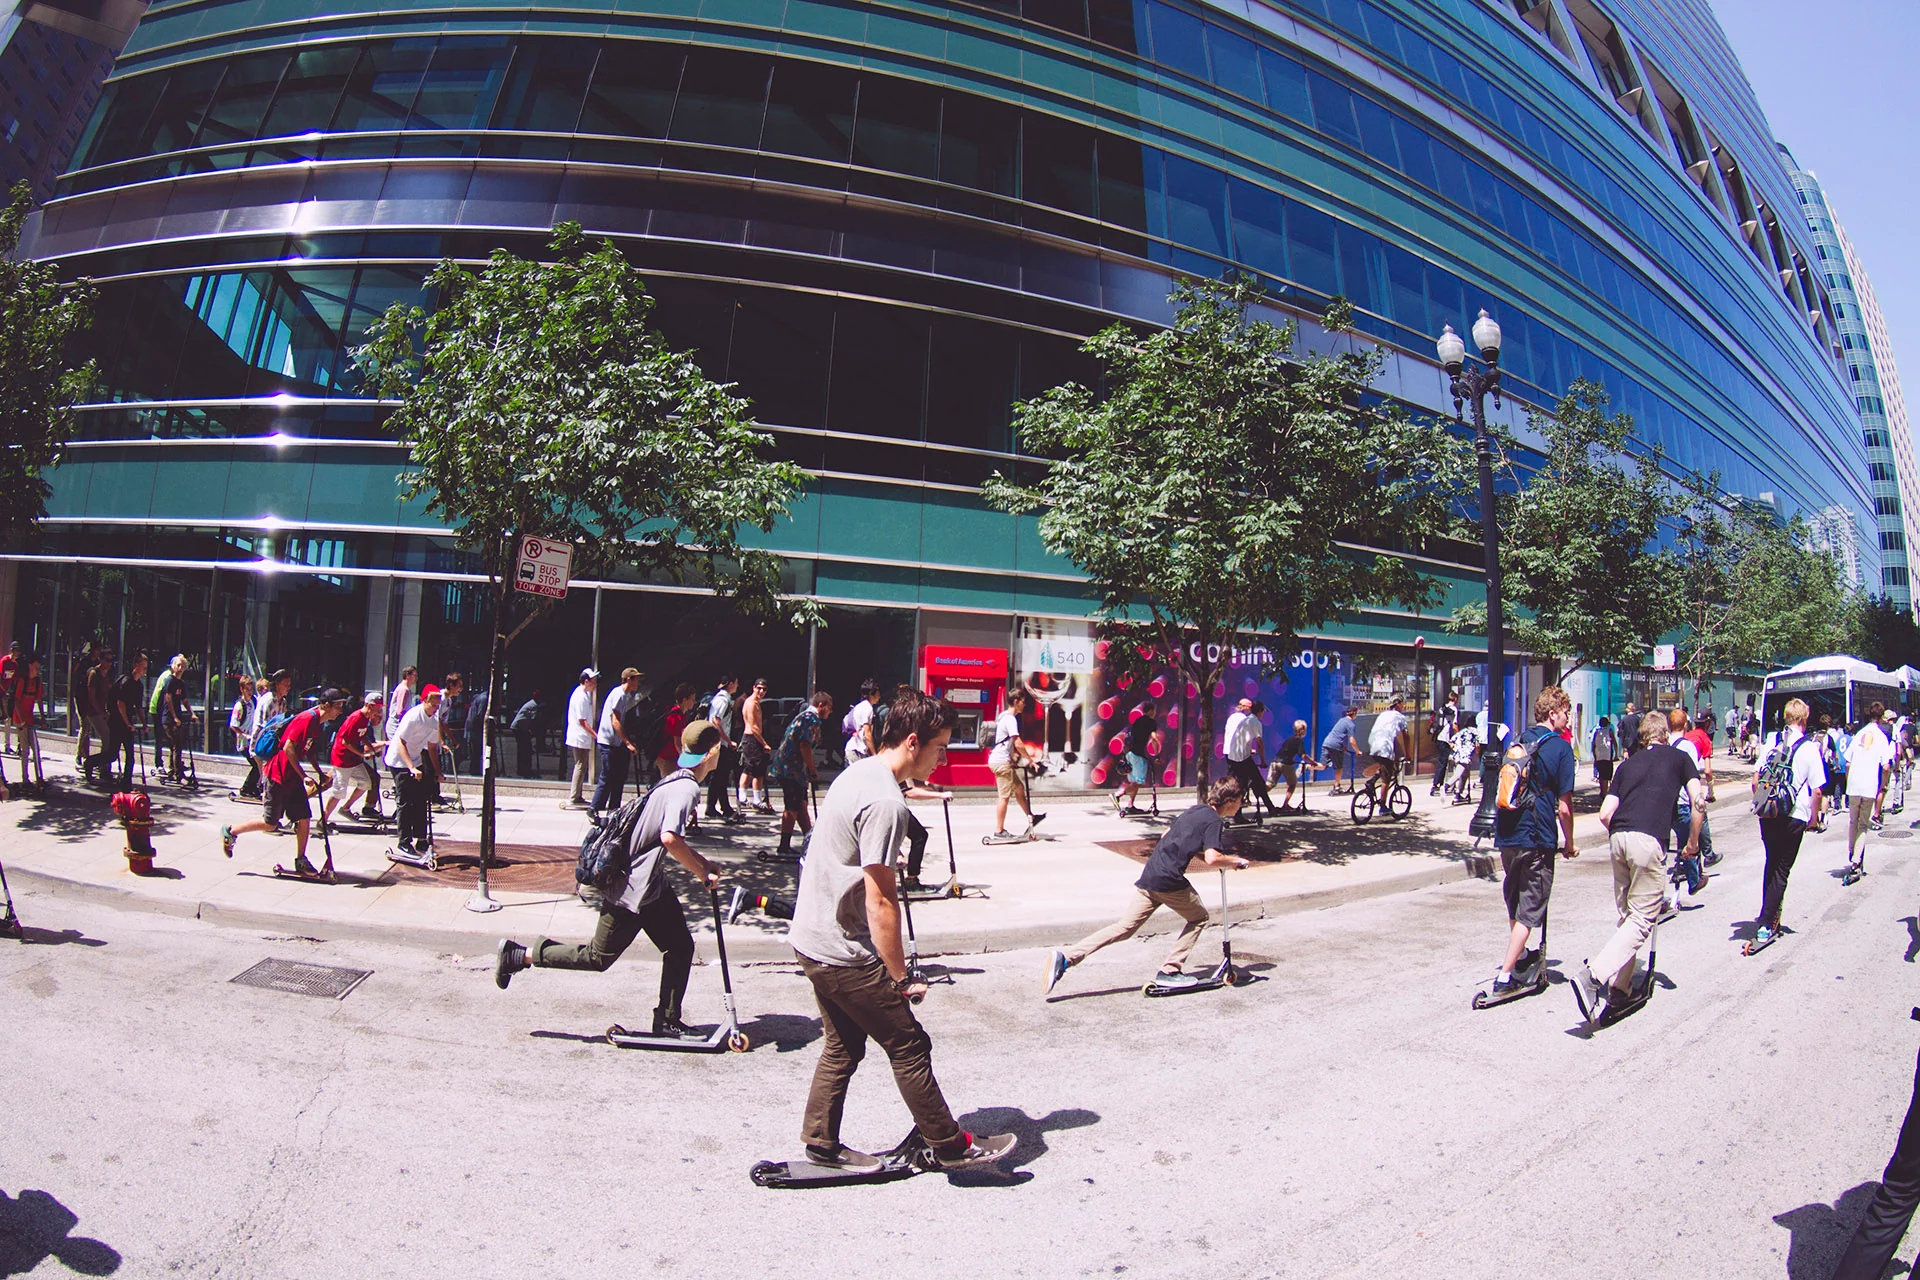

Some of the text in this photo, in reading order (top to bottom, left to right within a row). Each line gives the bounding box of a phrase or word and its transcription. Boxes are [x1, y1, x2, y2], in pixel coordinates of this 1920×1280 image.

[540, 565, 558, 576] BUS
[538, 574, 560, 586] STOP
[518, 582, 561, 596] TOW ZONE
[1057, 651, 1085, 665] 540
[1839, 737, 1847, 752] 8
